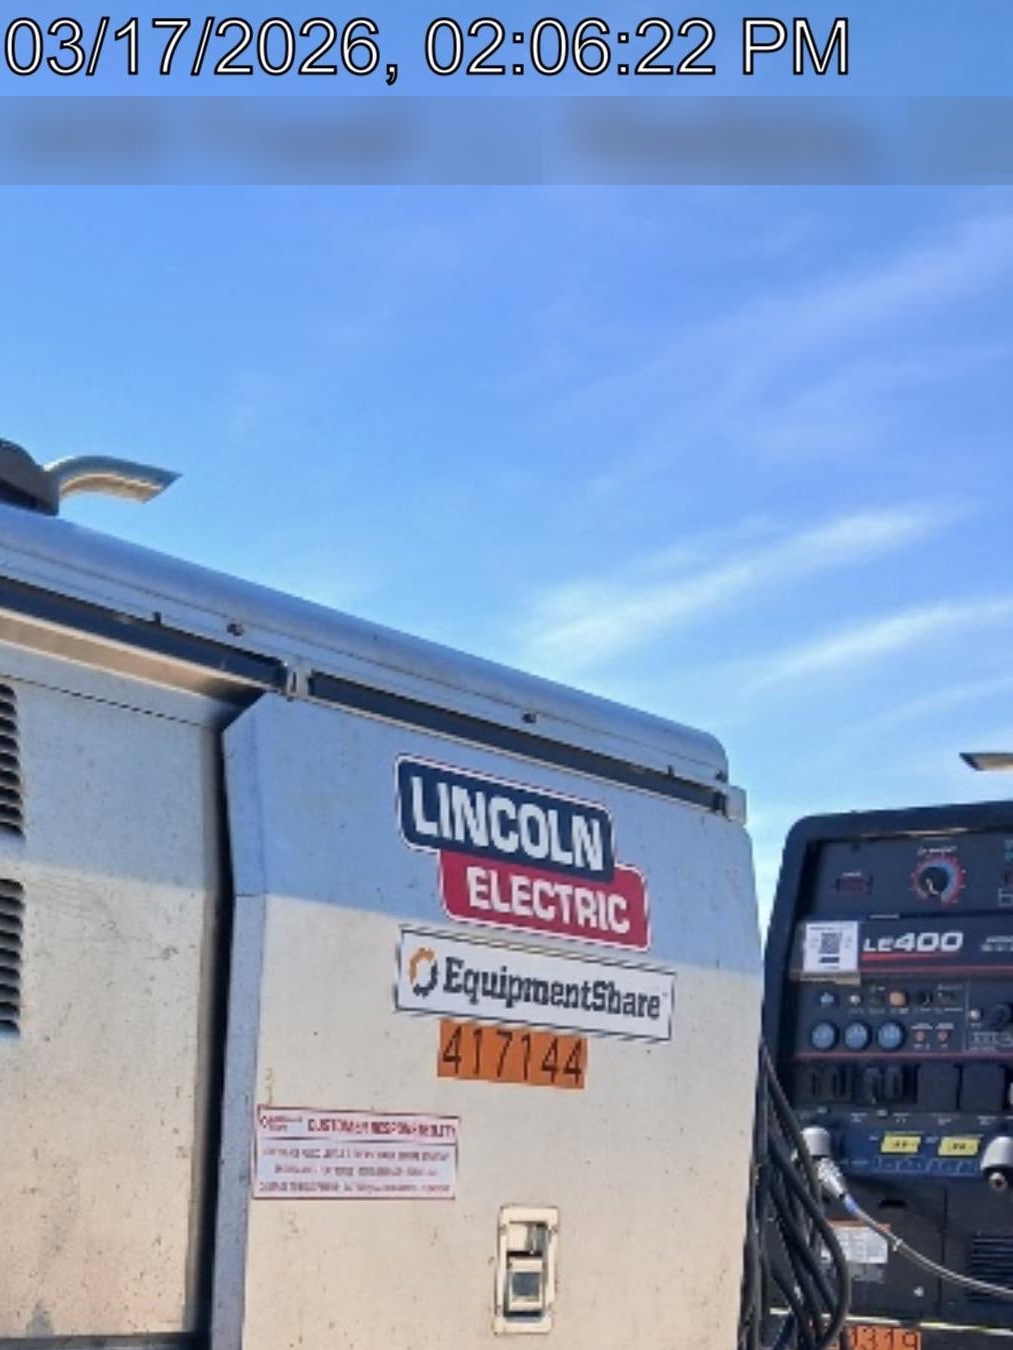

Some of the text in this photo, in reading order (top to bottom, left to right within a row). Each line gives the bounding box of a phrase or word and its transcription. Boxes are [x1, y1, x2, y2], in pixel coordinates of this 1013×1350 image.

[411, 776, 604, 871] LINCOLN
[466, 866, 630, 935] ELECTRIC
[863, 931, 963, 952] LE400
[443, 955, 661, 1021] EquipmentShare
[441, 1023, 582, 1085] 417144
